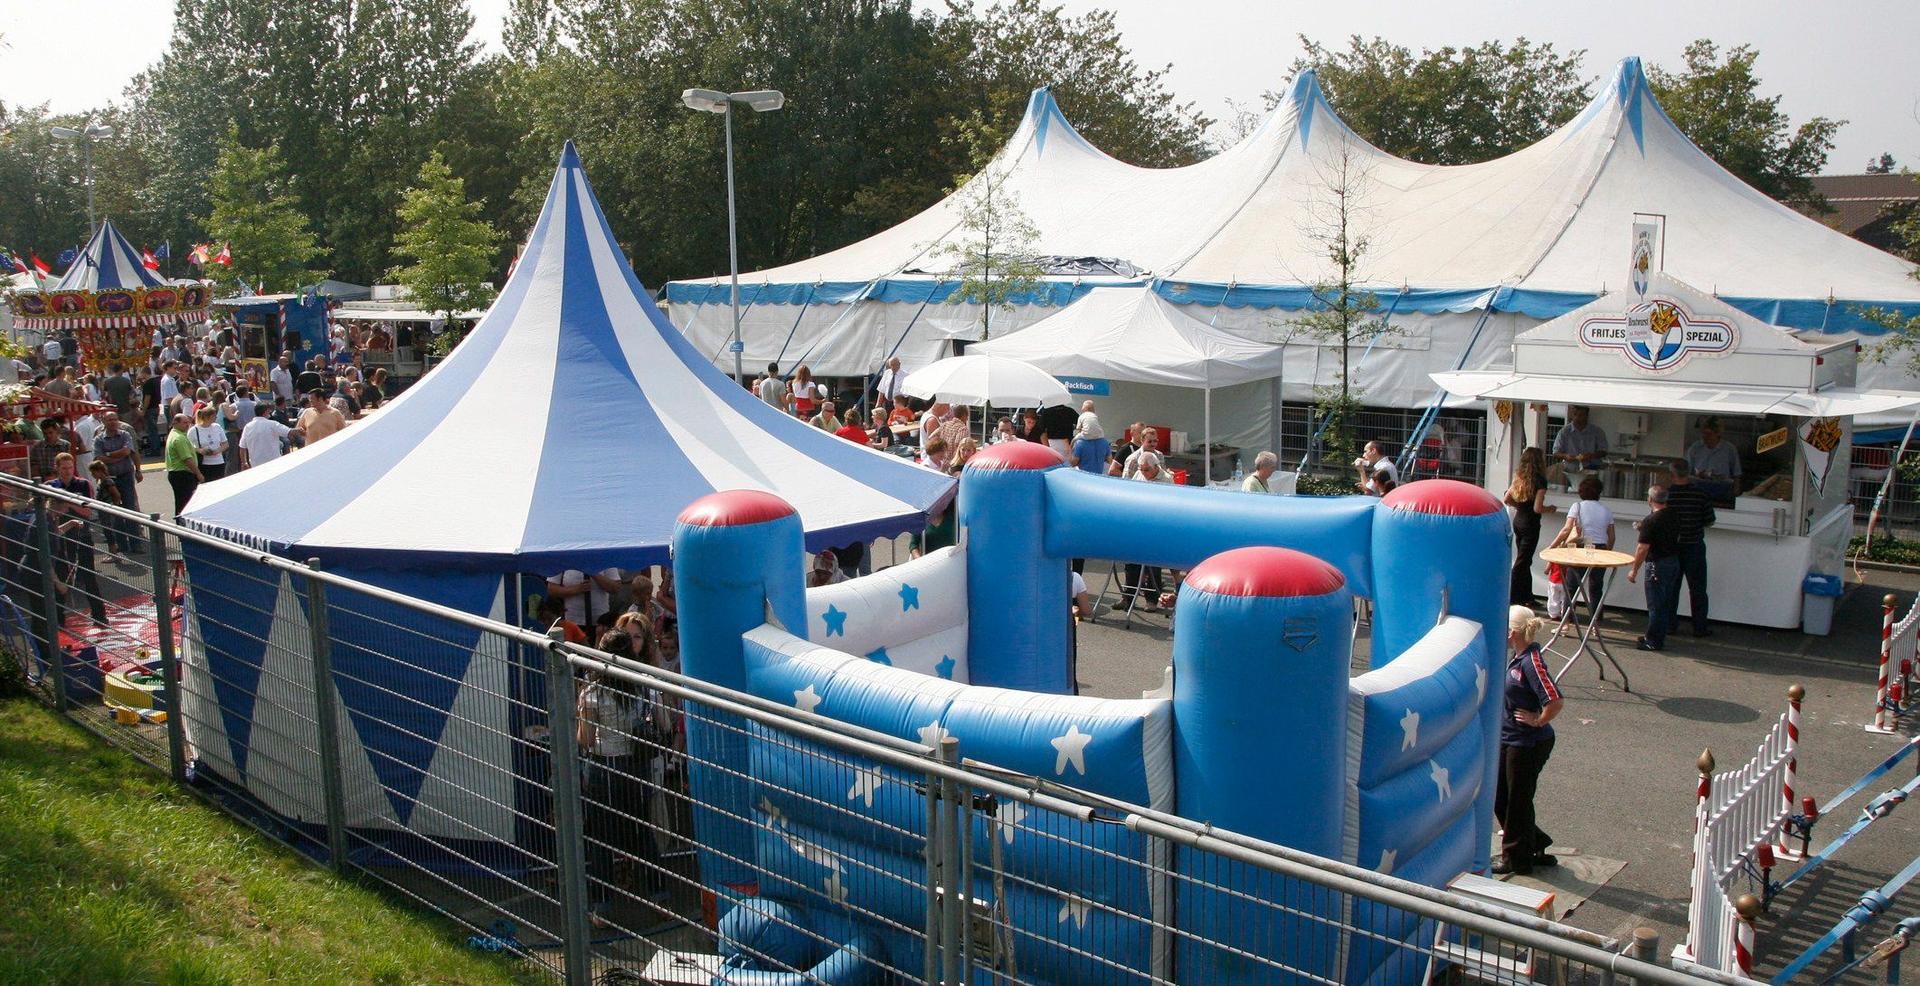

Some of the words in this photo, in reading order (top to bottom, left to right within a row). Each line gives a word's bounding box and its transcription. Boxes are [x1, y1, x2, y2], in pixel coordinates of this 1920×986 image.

[1591, 328, 1626, 339] FRITJES
[1686, 331, 1724, 343] SPEZIAL
[1064, 381, 1094, 391] Backfisch
